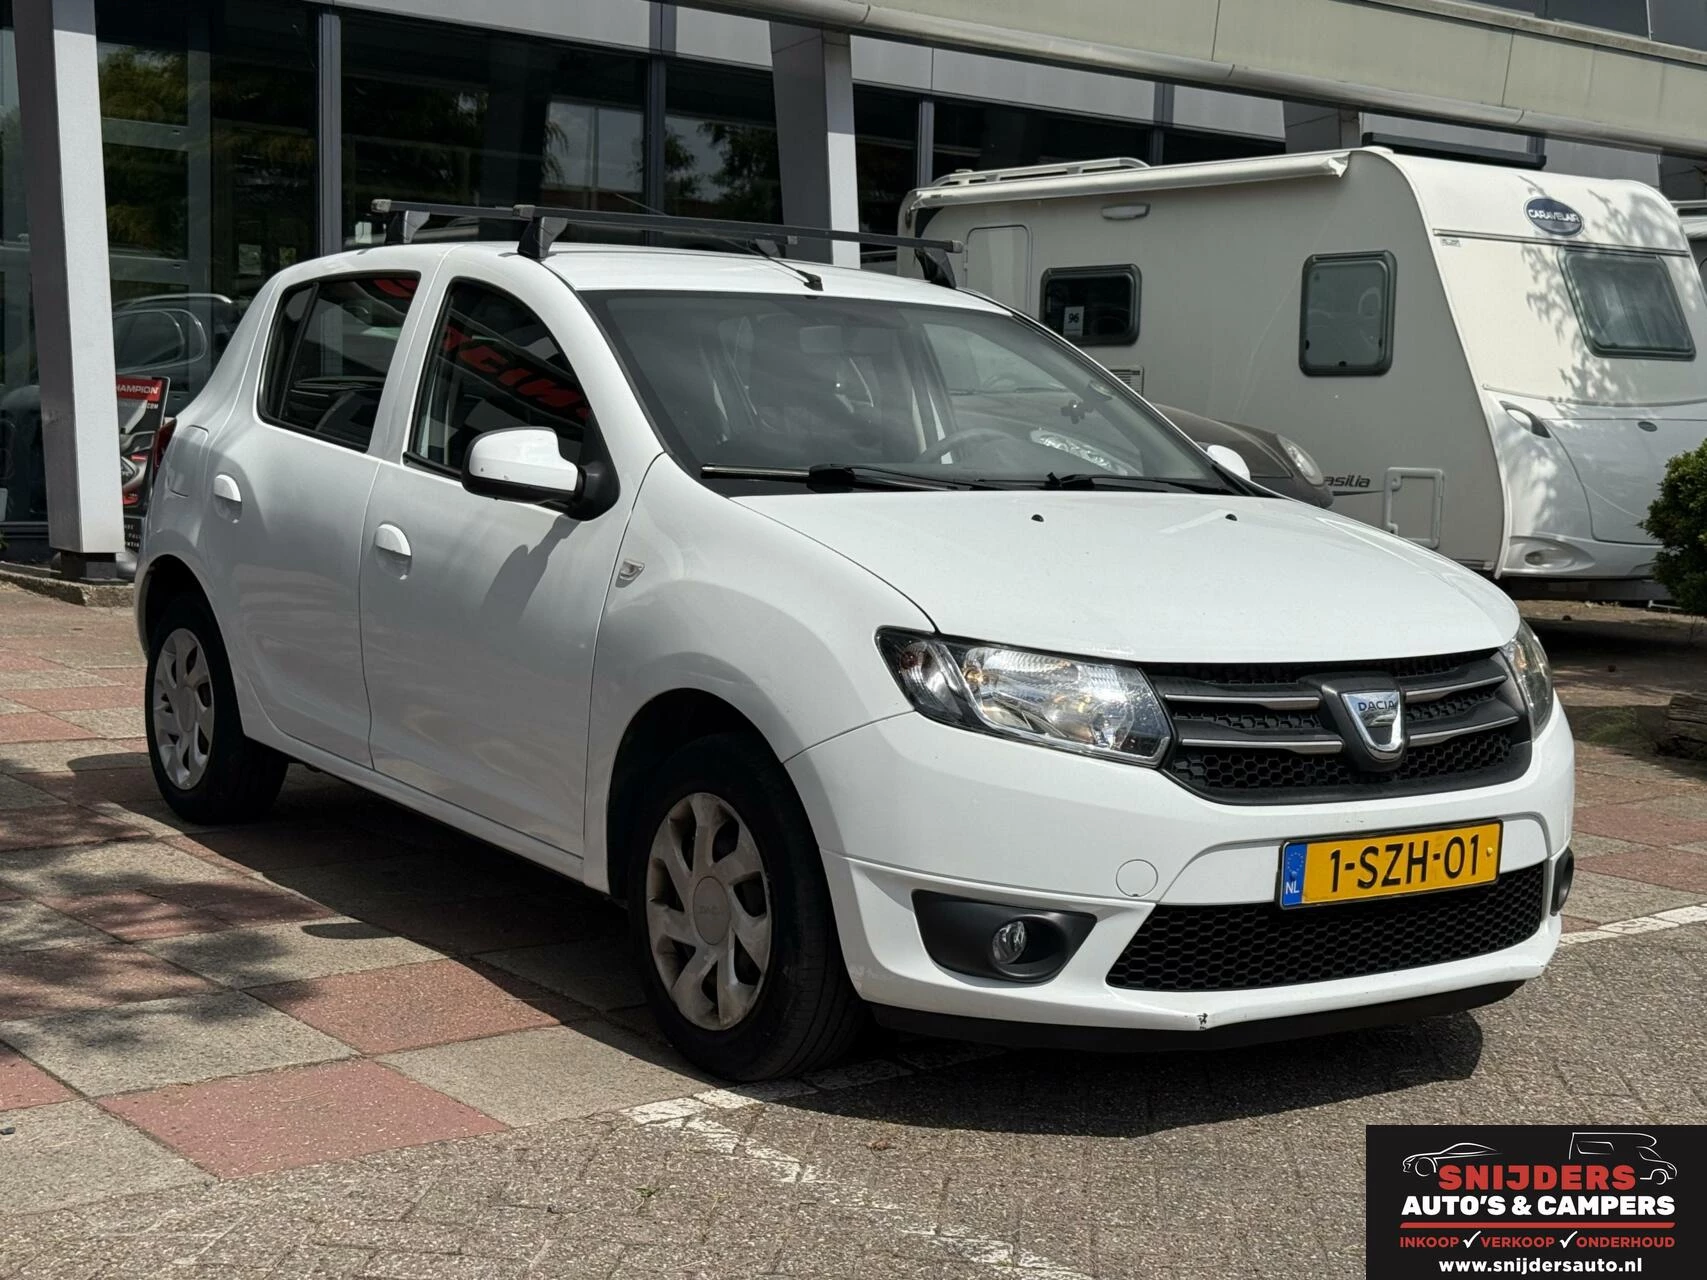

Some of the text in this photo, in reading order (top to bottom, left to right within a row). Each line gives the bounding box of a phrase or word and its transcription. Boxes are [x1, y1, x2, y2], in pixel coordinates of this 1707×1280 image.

[1528, 209, 1580, 222] CARAVELAIR
[1357, 699, 1396, 711] DACIA
[1330, 834, 1480, 892] 1-SZH-01
[1285, 881, 1300, 894] NL
